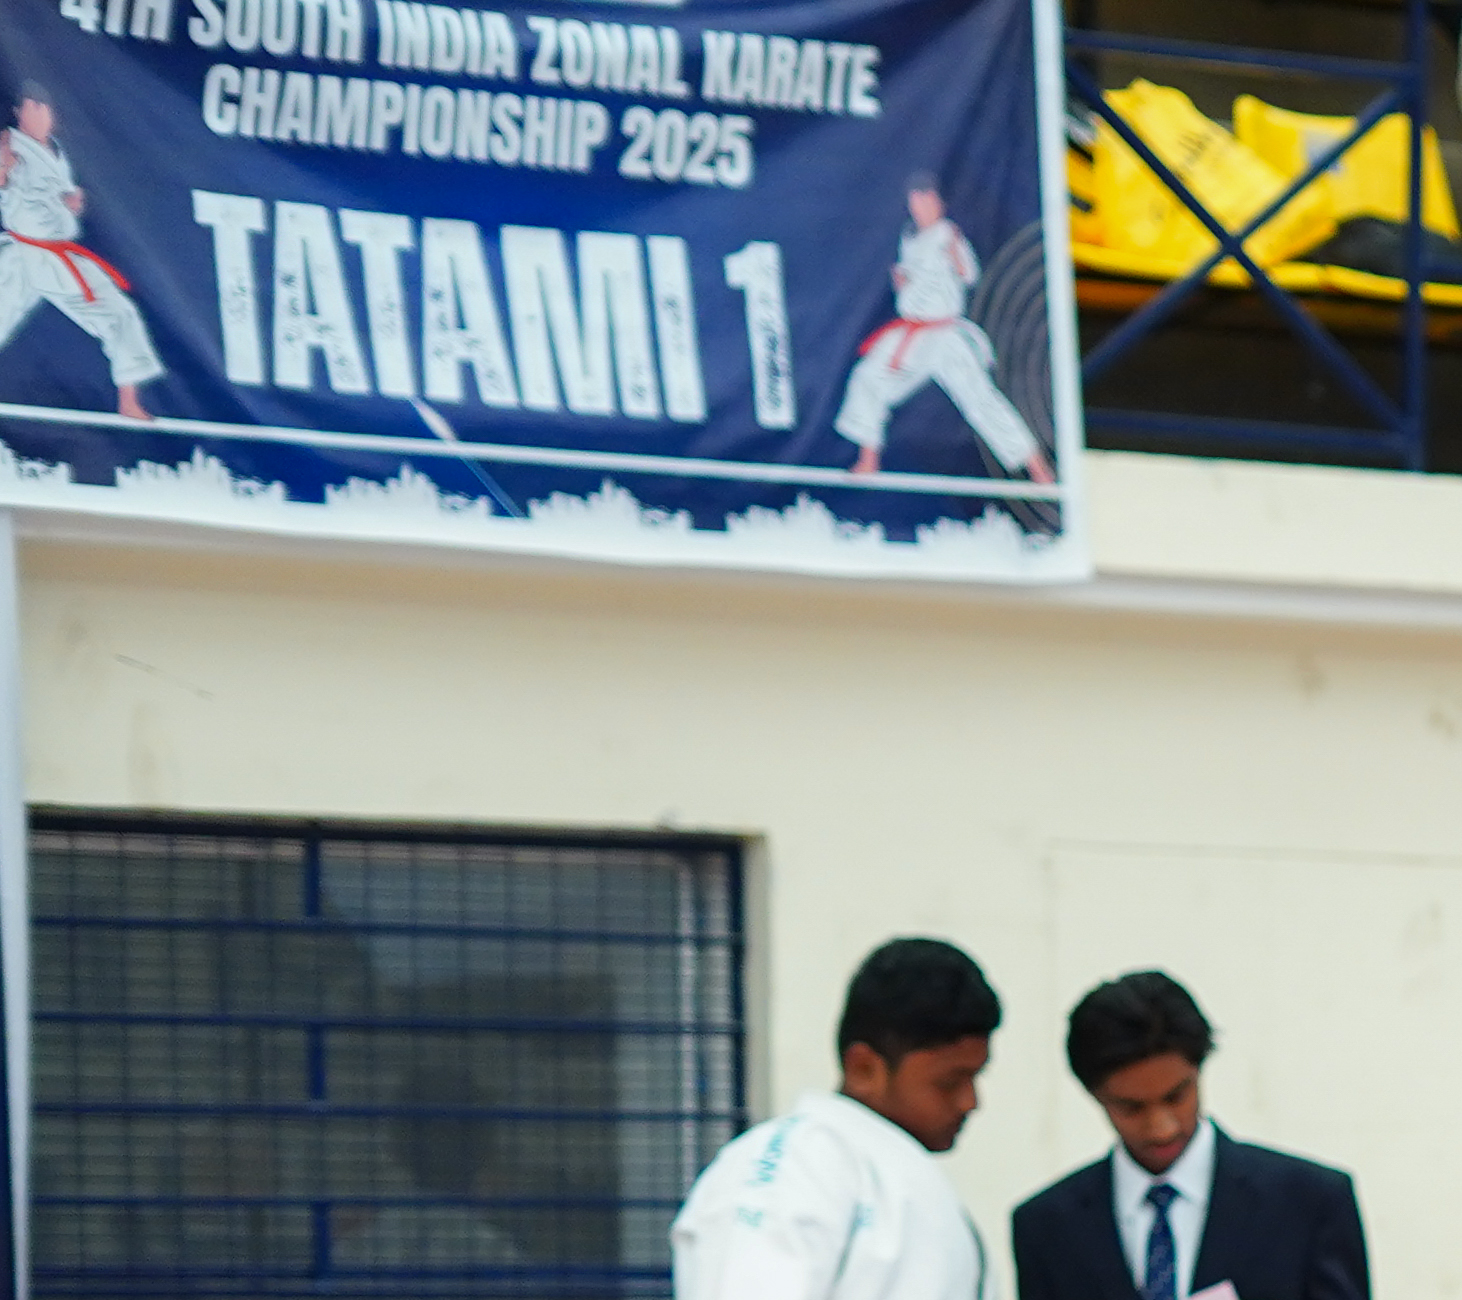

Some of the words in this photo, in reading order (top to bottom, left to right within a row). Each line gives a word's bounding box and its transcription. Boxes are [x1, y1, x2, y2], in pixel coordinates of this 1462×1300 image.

[188, 0, 364, 65] SOUTH
[377, 0, 519, 81] INDIA
[527, 15, 692, 98] ZONAL
[701, 29, 884, 119] KARATE
[203, 63, 609, 174] CHAMPIONSHIP
[618, 105, 757, 189] 2025
[192, 189, 708, 423] TATAMI
[724, 240, 797, 431] 1
